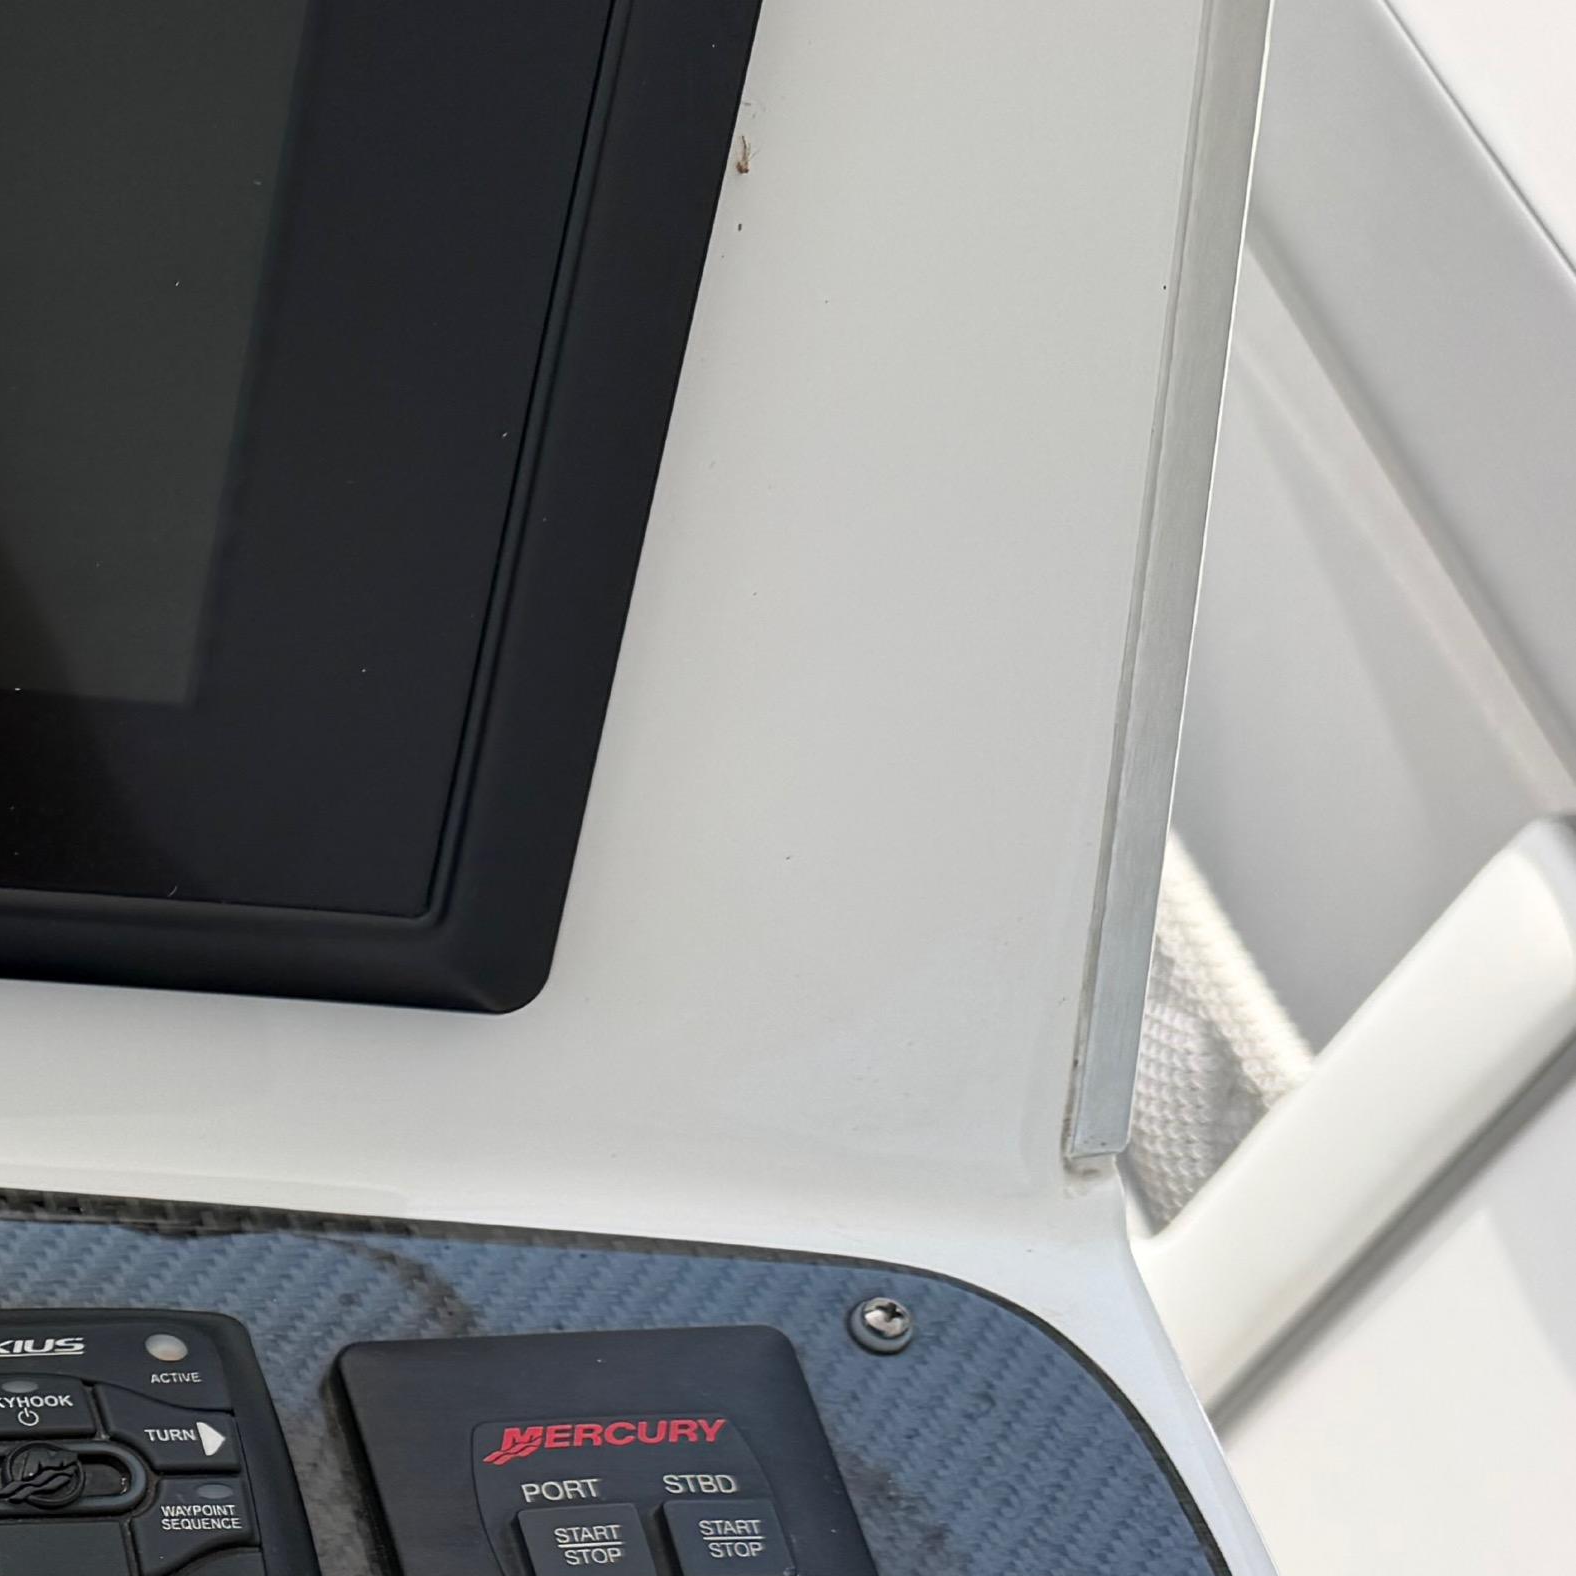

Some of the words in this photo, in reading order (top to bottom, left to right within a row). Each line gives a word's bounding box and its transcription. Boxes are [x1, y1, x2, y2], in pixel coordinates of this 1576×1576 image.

[150, 1371, 202, 1384] ACTIVE
[145, 1427, 197, 1443] TURN
[482, 1418, 727, 1466] MERCURY
[521, 1478, 603, 1502] PORT
[662, 1473, 740, 1495] STBD
[160, 1503, 237, 1517] WAYPOINT
[160, 1516, 243, 1531] SEQUENCE
[698, 1518, 764, 1537] START
[553, 1524, 623, 1544] START
[564, 1547, 623, 1566] STOP
[708, 1541, 765, 1559] STOP
